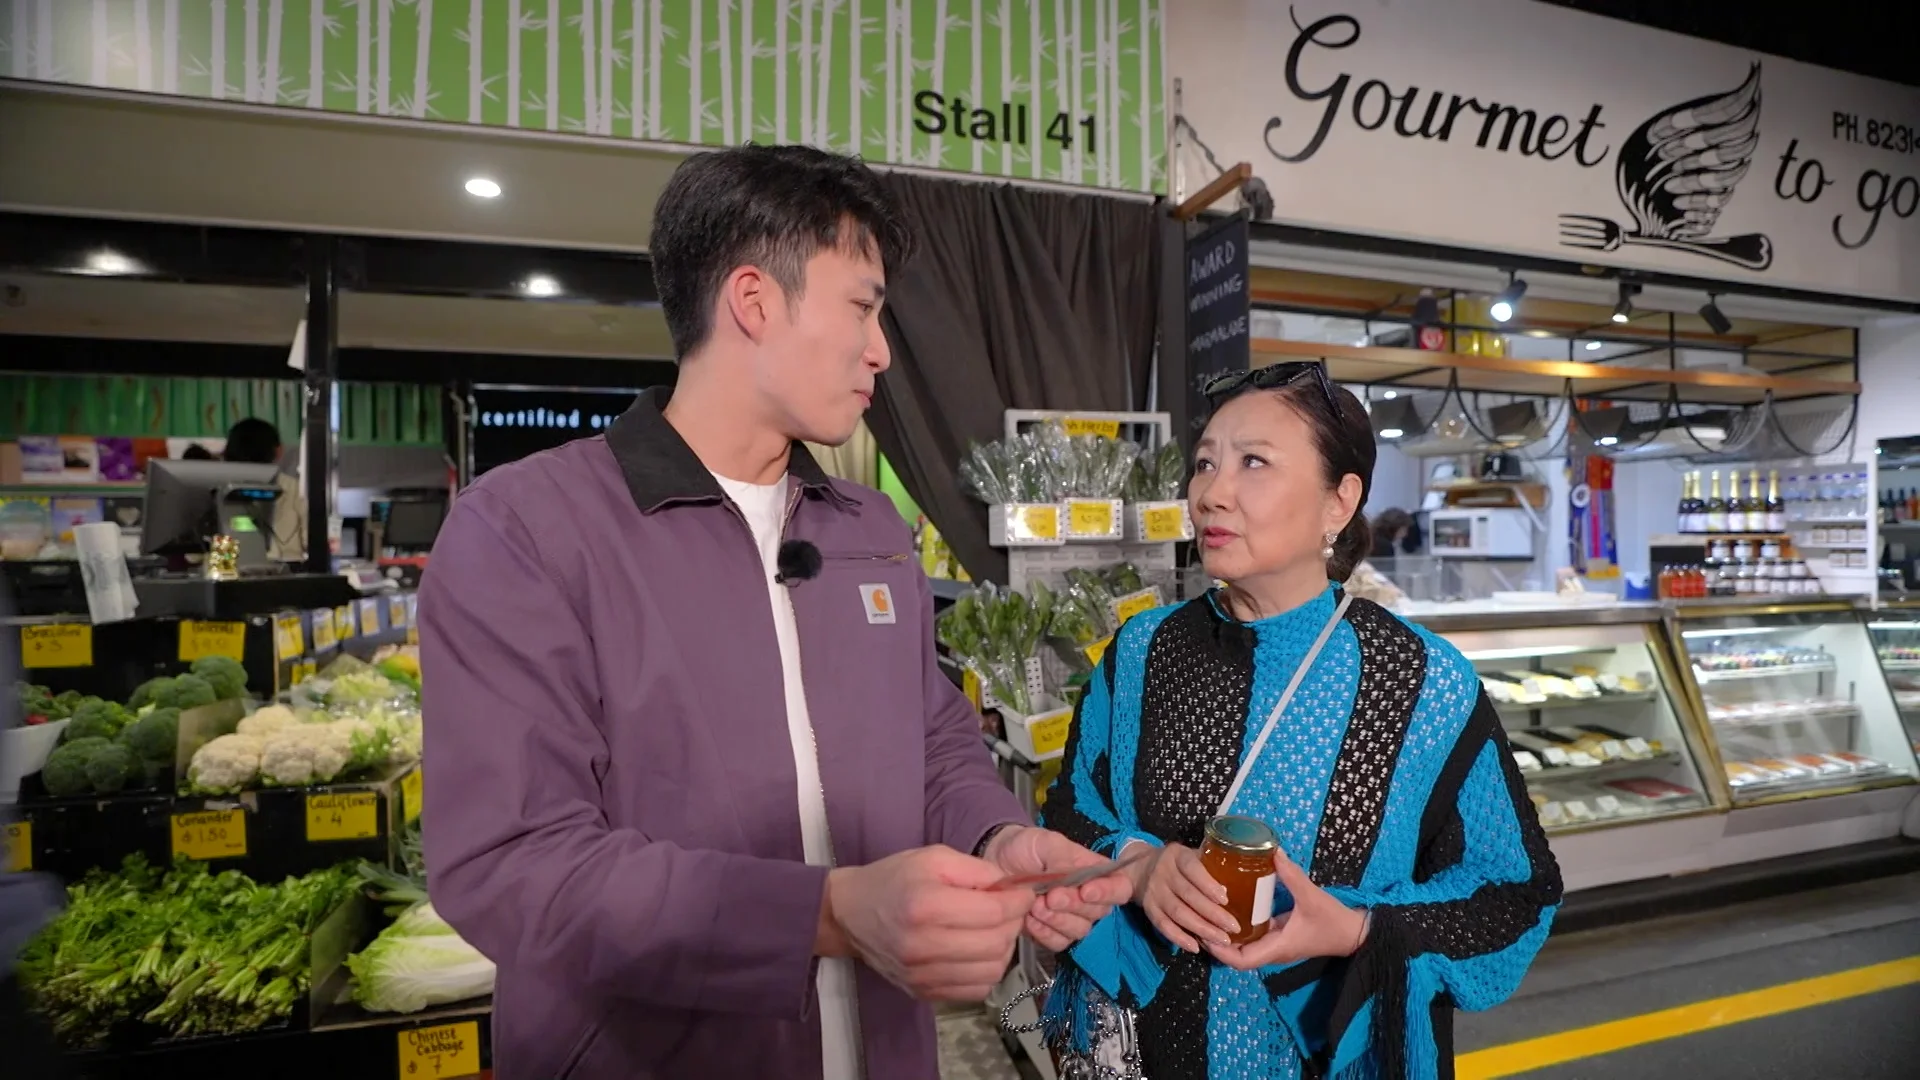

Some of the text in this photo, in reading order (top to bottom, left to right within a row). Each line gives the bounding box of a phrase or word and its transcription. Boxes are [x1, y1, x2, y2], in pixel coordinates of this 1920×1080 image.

[913, 90, 1096, 153] Stall 41
[1263, 4, 1920, 250] Gourmet to go
[1190, 240, 1236, 284] AWARD
[1190, 273, 1243, 313] WINNING
[176, 811, 233, 828] Coriander
[408, 1028, 457, 1046] Chinese
